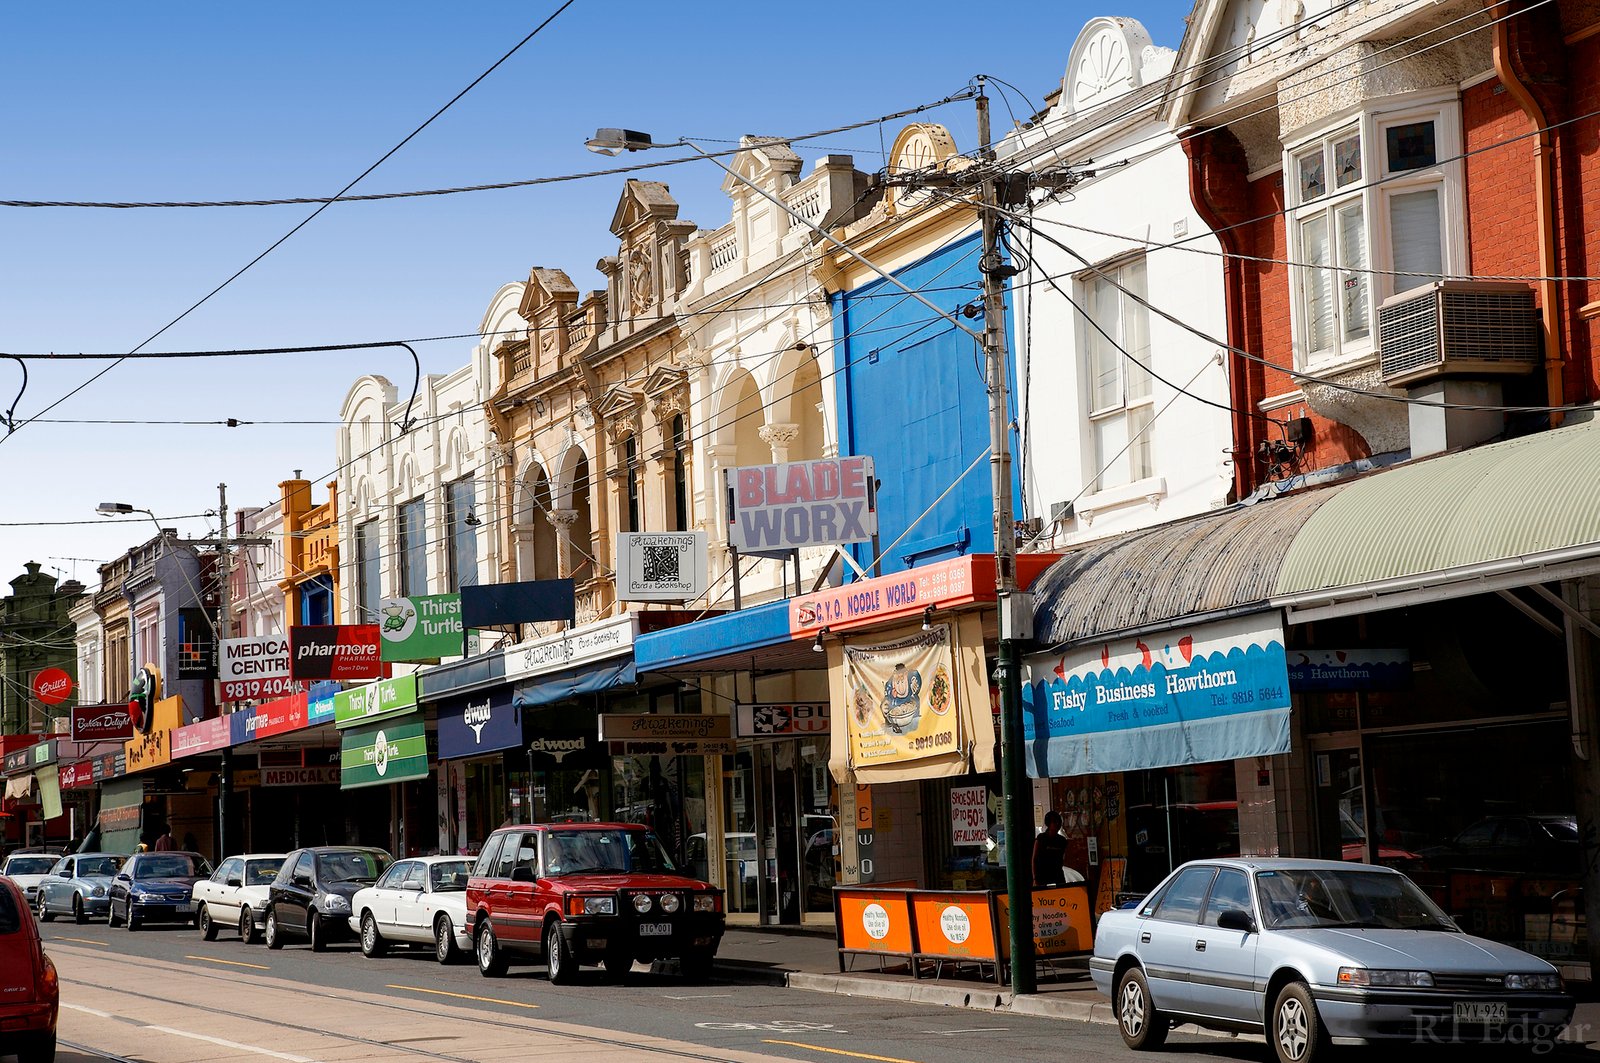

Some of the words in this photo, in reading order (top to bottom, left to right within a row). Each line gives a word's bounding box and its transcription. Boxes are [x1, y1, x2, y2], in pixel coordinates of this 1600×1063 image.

[737, 459, 866, 508] BLADE
[740, 501, 867, 548] WORX
[631, 536, 693, 552] Awakenings
[932, 573, 947, 585] 9819
[949, 568, 965, 580] 0368
[655, 582, 692, 590] Bookshop
[933, 585, 948, 597] 9819
[949, 580, 965, 593] 0397
[847, 589, 881, 616] NOODLE
[886, 581, 916, 607] WORLD
[420, 599, 462, 616] Thirst
[421, 619, 464, 635] Turtle
[227, 640, 289, 659] MEDICA
[297, 642, 377, 660] pharmore
[1310, 668, 1370, 679] Hawthorn
[226, 682, 260, 698] 9819
[1052, 689, 1087, 712] Fishy
[1095, 681, 1157, 705] Business
[1165, 668, 1238, 695] Hawthorn
[1210, 693, 1229, 706] Tel:
[1232, 690, 1255, 705] 9818
[1258, 685, 1284, 701] 5644
[464, 698, 492, 725] elwood
[1108, 709, 1130, 723] Fresh
[1142, 704, 1169, 718] cooked
[631, 717, 716, 737] Awakenings
[1048, 716, 1076, 730] Seafood
[530, 736, 587, 751] elwood
[266, 769, 322, 784] MEDICAL
[967, 790, 985, 806] SALE
[1038, 897, 1057, 906] Your
[1039, 921, 1053, 929] olive
[1054, 919, 1063, 928] oil
[1042, 911, 1068, 920] Noodles
